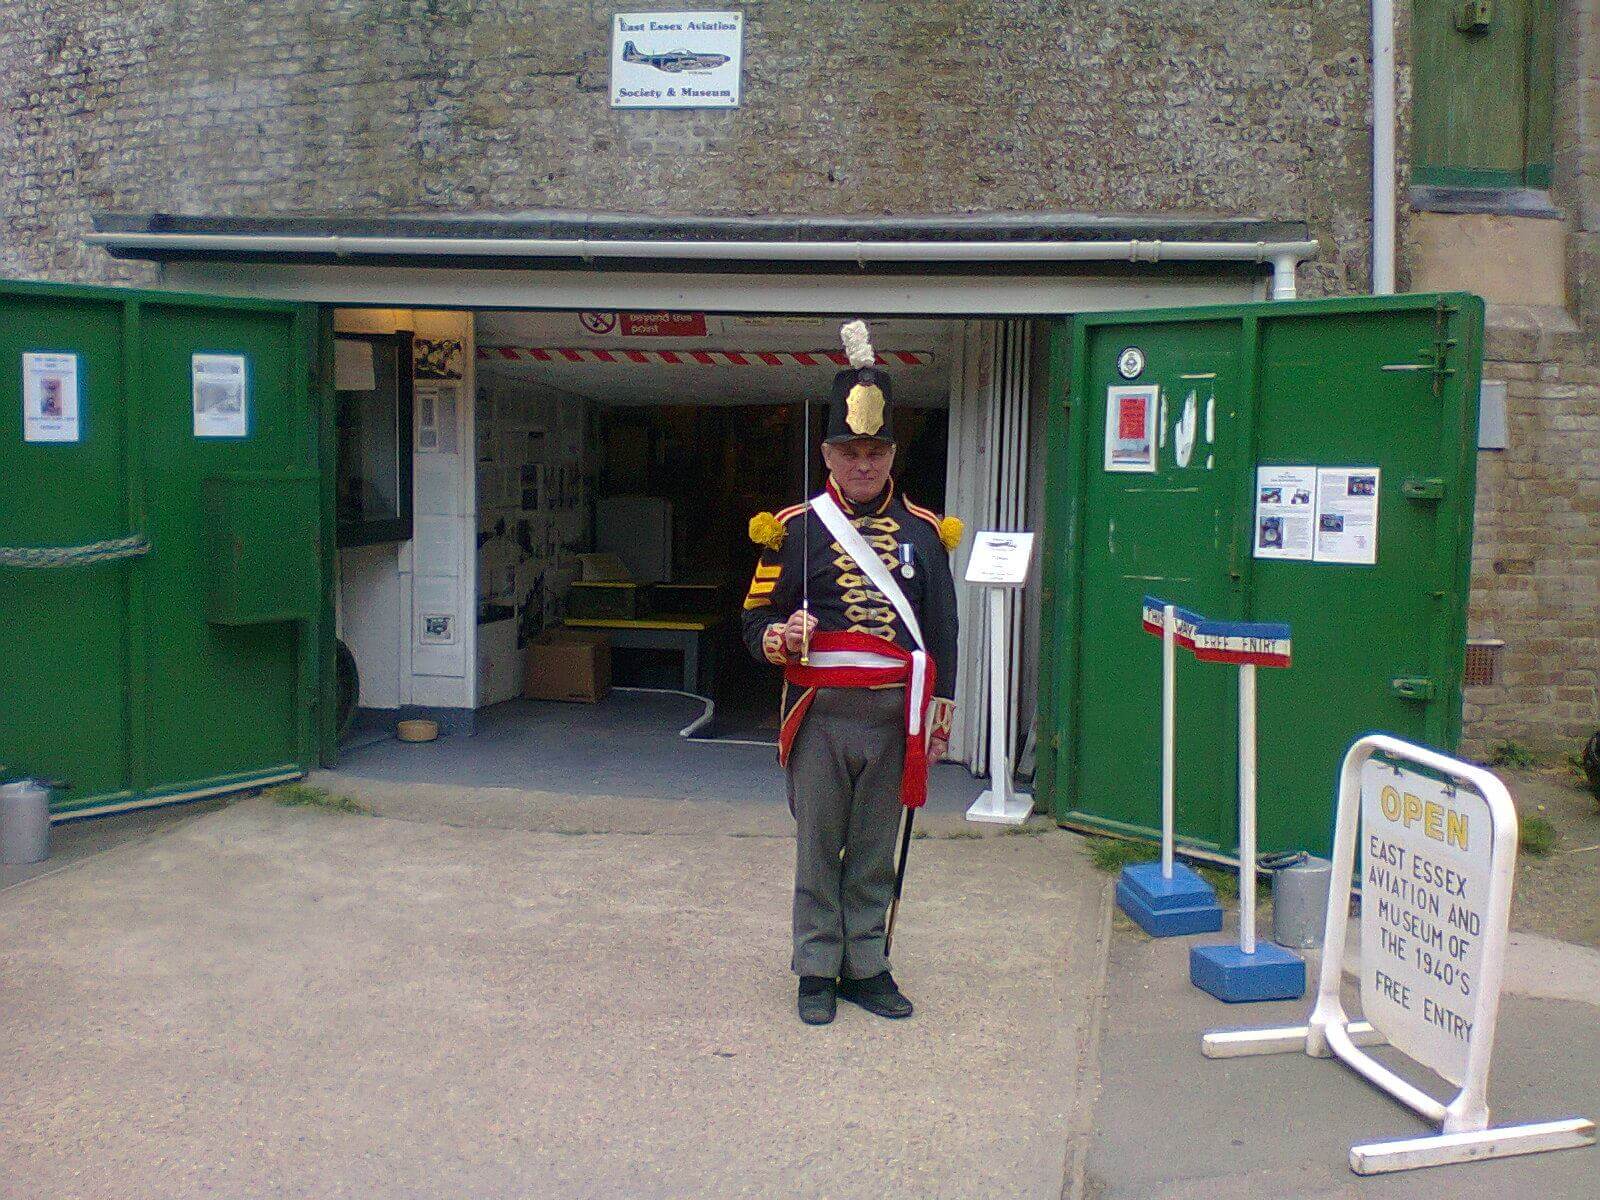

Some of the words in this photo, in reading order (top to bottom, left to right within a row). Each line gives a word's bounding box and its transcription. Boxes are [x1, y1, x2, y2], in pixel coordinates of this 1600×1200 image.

[619, 21, 645, 32] East
[650, 22, 683, 31] Essex
[687, 21, 737, 31] Aviation
[619, 87, 661, 99] Society
[666, 87, 676, 97] &
[681, 87, 731, 97] Museum
[1381, 784, 1469, 851] OPEN
[1369, 864, 1440, 917] AVIATION
[1448, 903, 1480, 936] AND
[1370, 835, 1406, 870] EAST
[1413, 854, 1467, 899] ESSEX
[1379, 897, 1443, 951] MUSEUM
[1448, 935, 1470, 962] OF
[1380, 926, 1407, 960] THE
[1416, 947, 1470, 996] 1940'S
[1376, 969, 1411, 1010] FREE
[1423, 997, 1473, 1042] ENTRY
